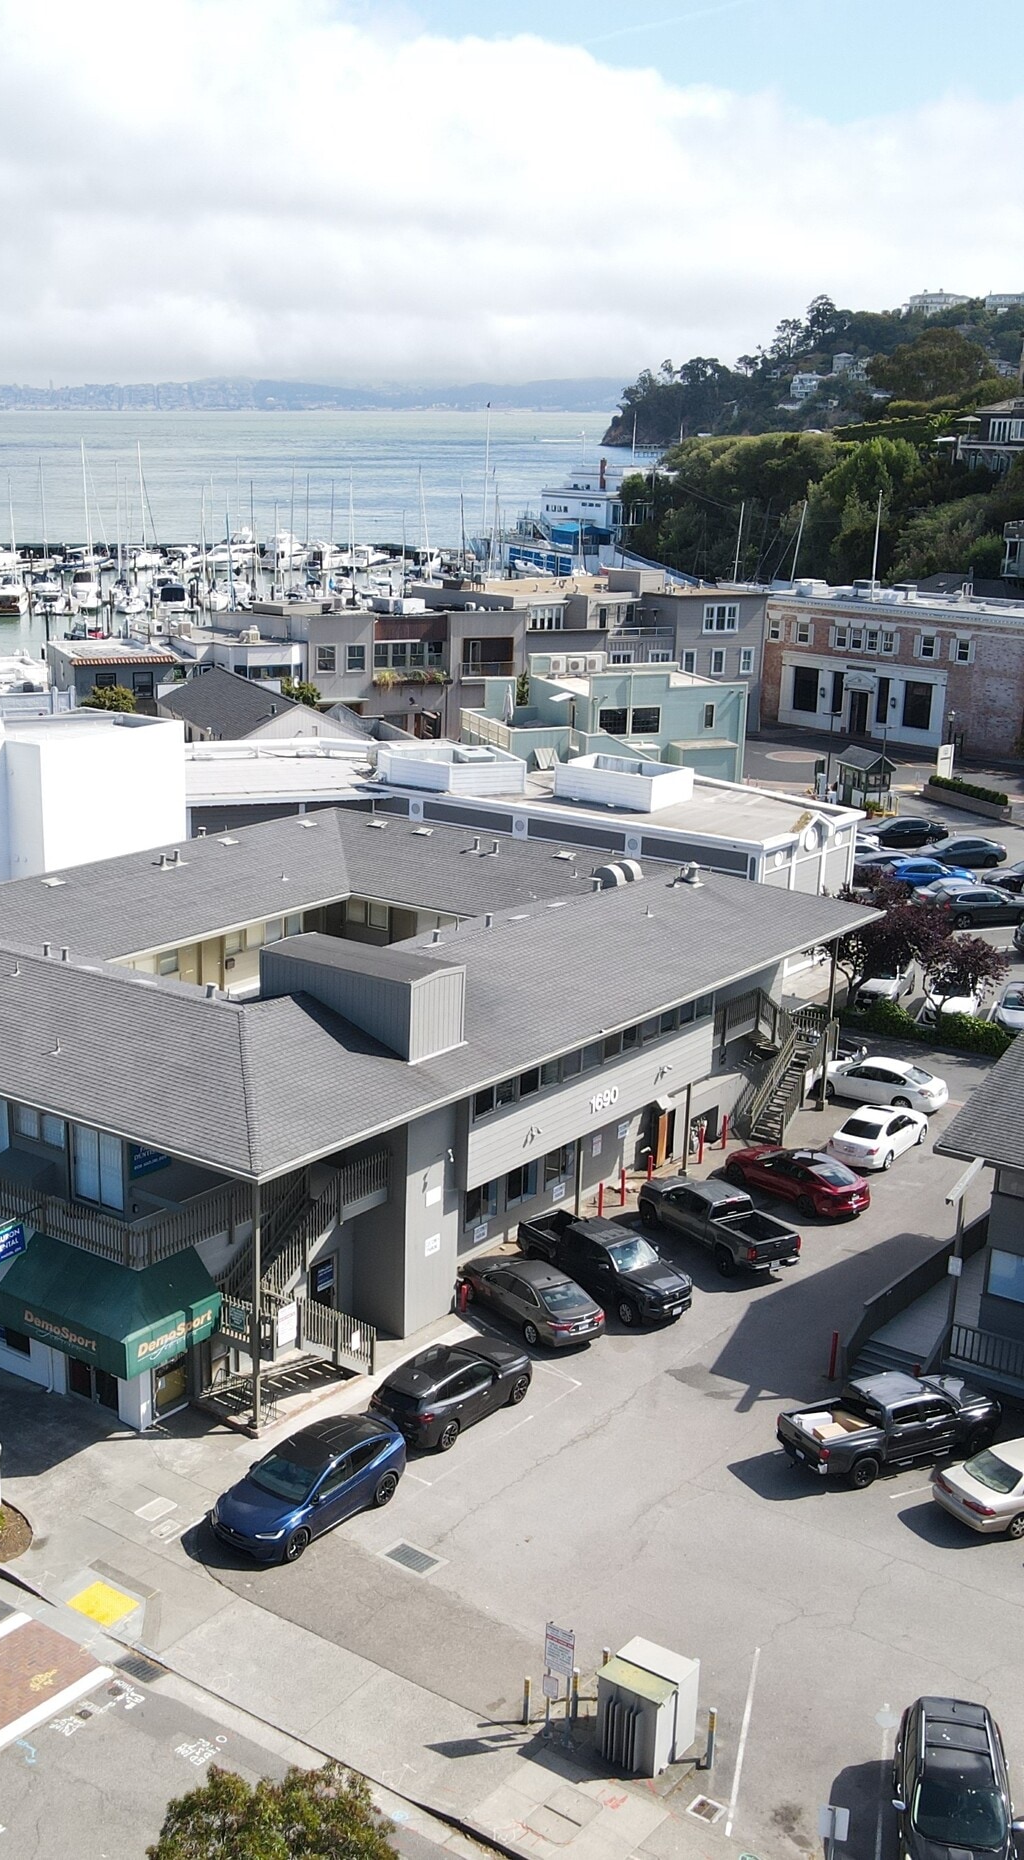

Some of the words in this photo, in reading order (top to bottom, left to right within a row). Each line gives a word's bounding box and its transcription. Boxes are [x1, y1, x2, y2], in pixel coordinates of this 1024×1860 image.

[590, 1086, 619, 1113] 1690
[24, 1309, 97, 1352] DemoSport
[137, 1309, 212, 1358] DemoSport
